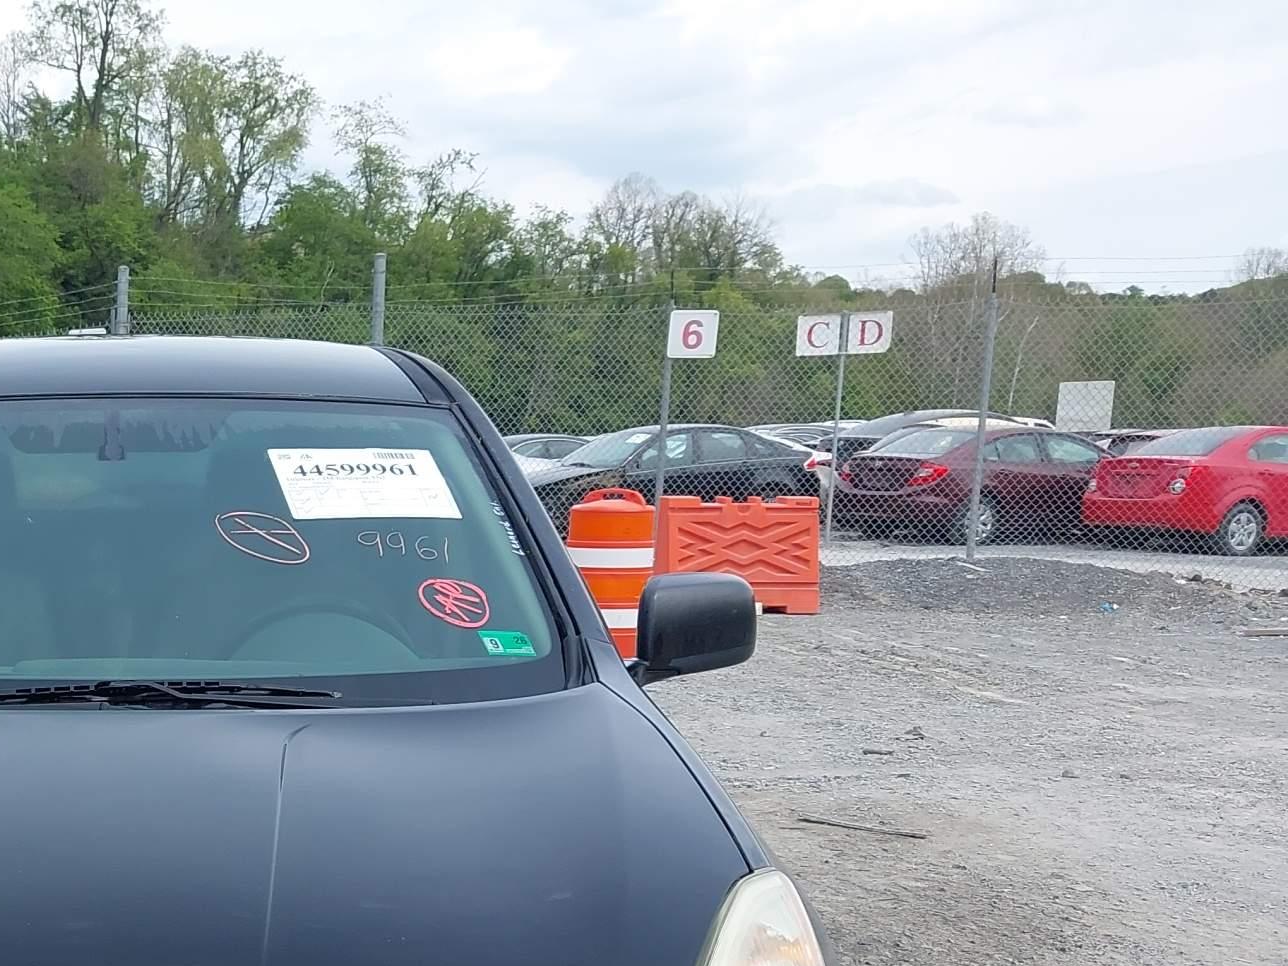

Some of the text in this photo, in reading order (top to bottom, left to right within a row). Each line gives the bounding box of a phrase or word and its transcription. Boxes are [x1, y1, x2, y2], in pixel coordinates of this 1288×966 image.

[682, 319, 704, 350] 6
[807, 321, 830, 348] C
[857, 319, 884, 346] D
[293, 463, 418, 477] 44599961
[357, 529, 450, 565] 9961
[489, 638, 500, 649] 9
